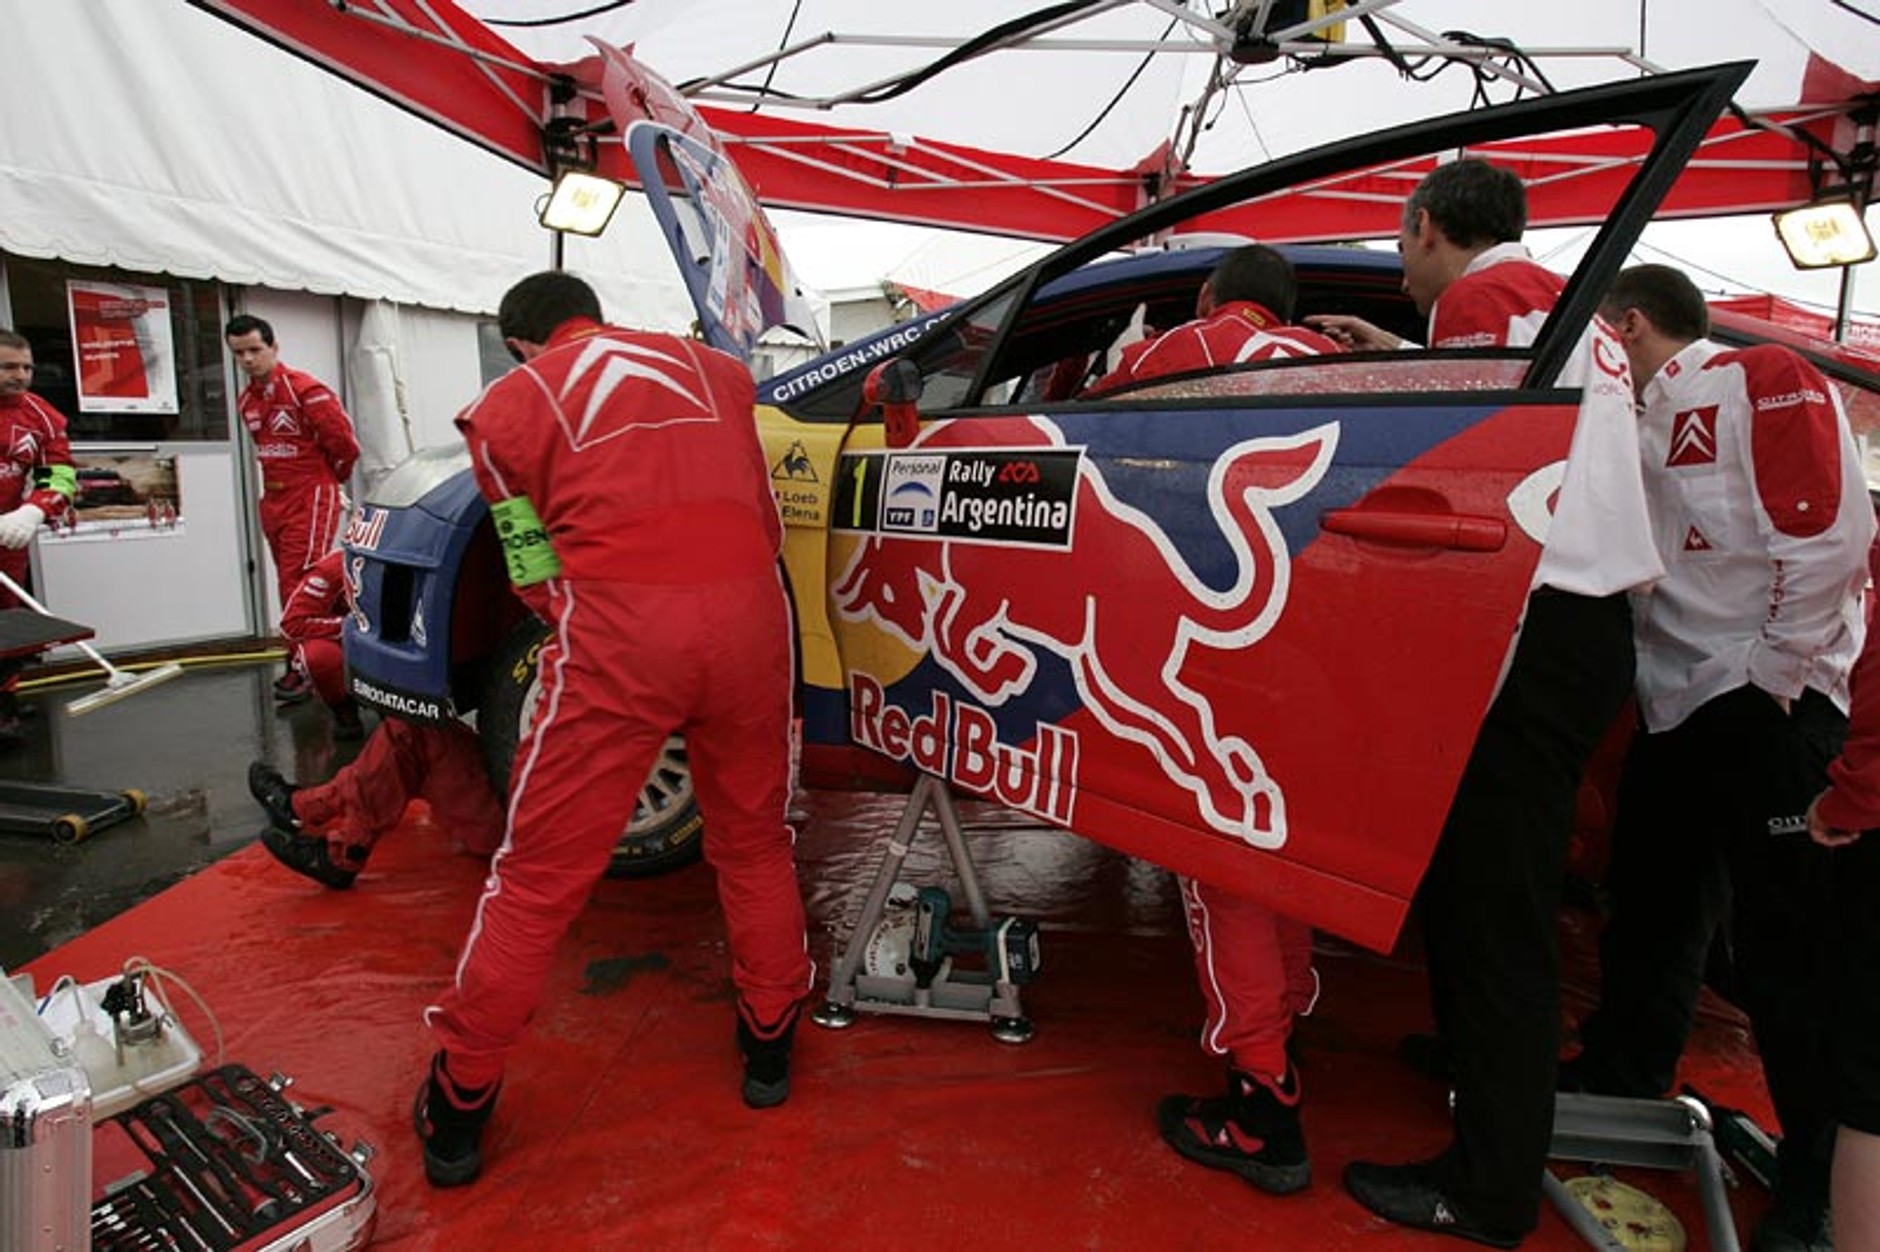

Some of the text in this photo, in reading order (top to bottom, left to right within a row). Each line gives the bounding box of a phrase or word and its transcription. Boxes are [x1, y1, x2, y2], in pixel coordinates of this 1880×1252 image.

[891, 460, 943, 476] Personal
[949, 461, 996, 488] Rally
[783, 490, 818, 504] Loeb
[853, 457, 868, 528] 1
[783, 505, 820, 520] Elena
[940, 491, 1068, 532] Argentina
[850, 669, 950, 780] Red
[951, 699, 1078, 828] Bull
